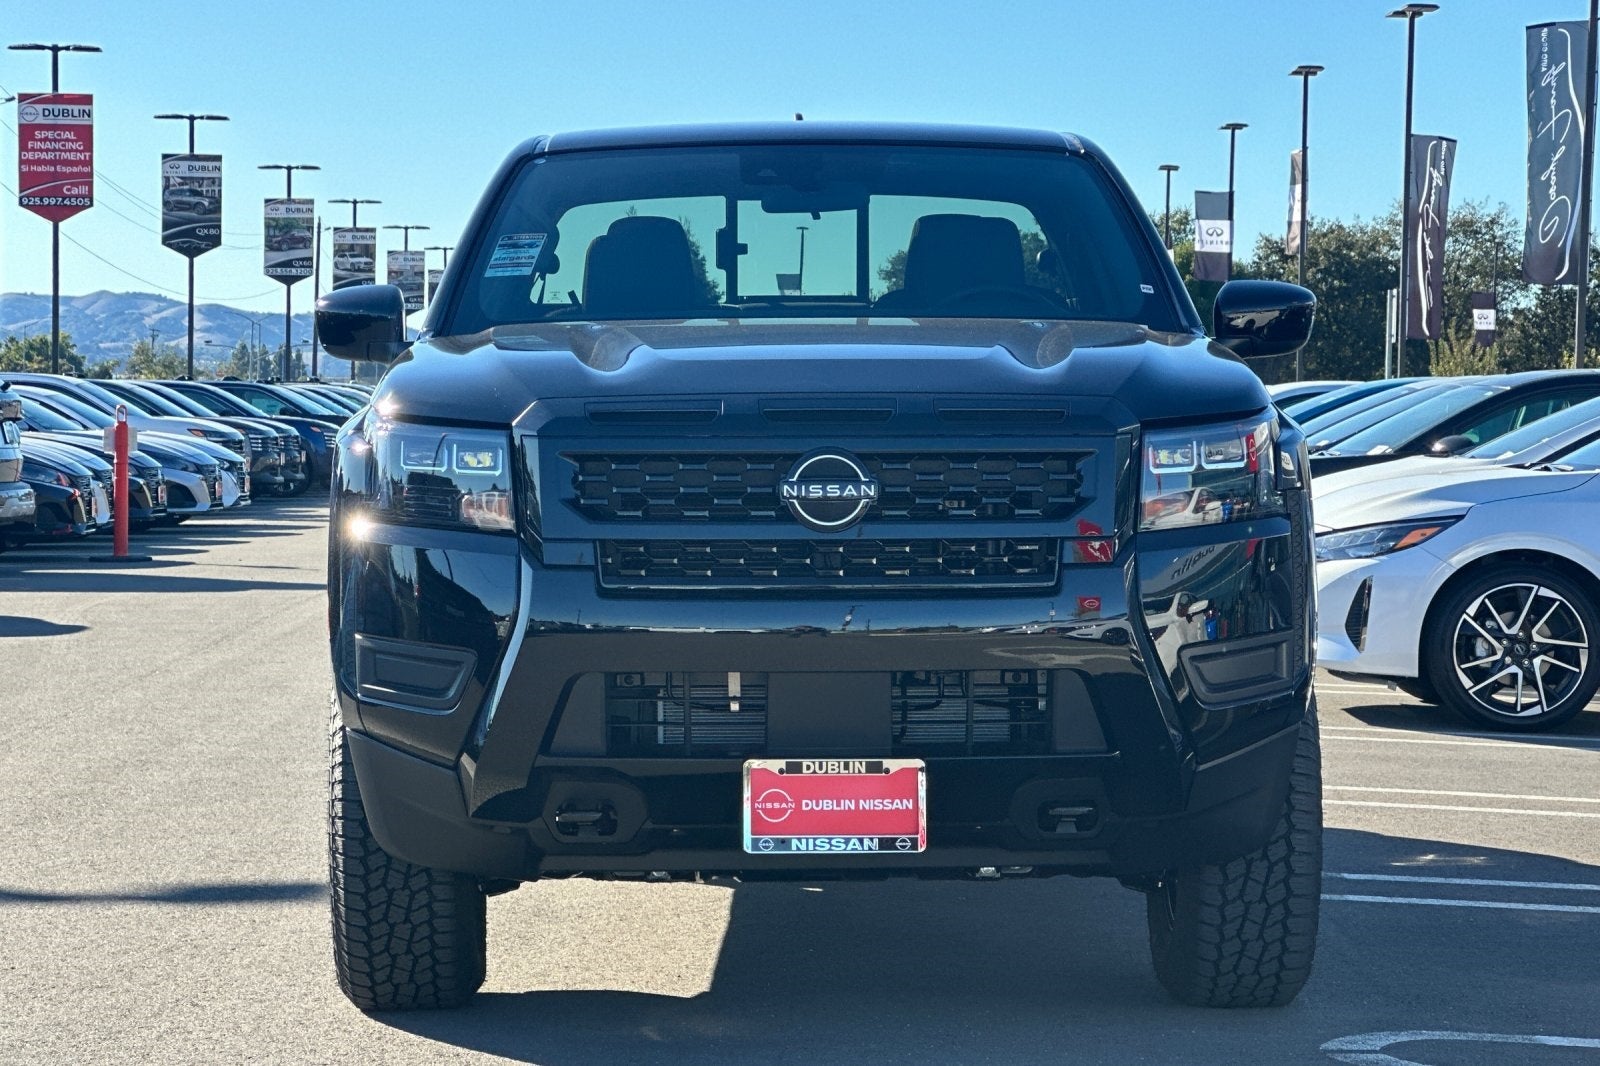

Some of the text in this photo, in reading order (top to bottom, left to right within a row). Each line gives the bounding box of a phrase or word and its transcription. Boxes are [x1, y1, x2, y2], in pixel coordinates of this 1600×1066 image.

[42, 108, 91, 118] DUBLIN
[34, 130, 77, 139] SPECIAL
[28, 141, 83, 150] FINANCING
[21, 151, 91, 161] DEPARTMENT
[30, 164, 54, 172] Habla
[187, 164, 221, 172] DUBLIN
[63, 185, 89, 195] Call!
[21, 197, 90, 206] 925.997.4505
[195, 228, 220, 236] QX80
[783, 484, 875, 497] NISSAN
[802, 761, 866, 774] DUBLIN
[801, 799, 913, 811] DUBLIN NISSAN
[791, 838, 879, 851] NISSAN
